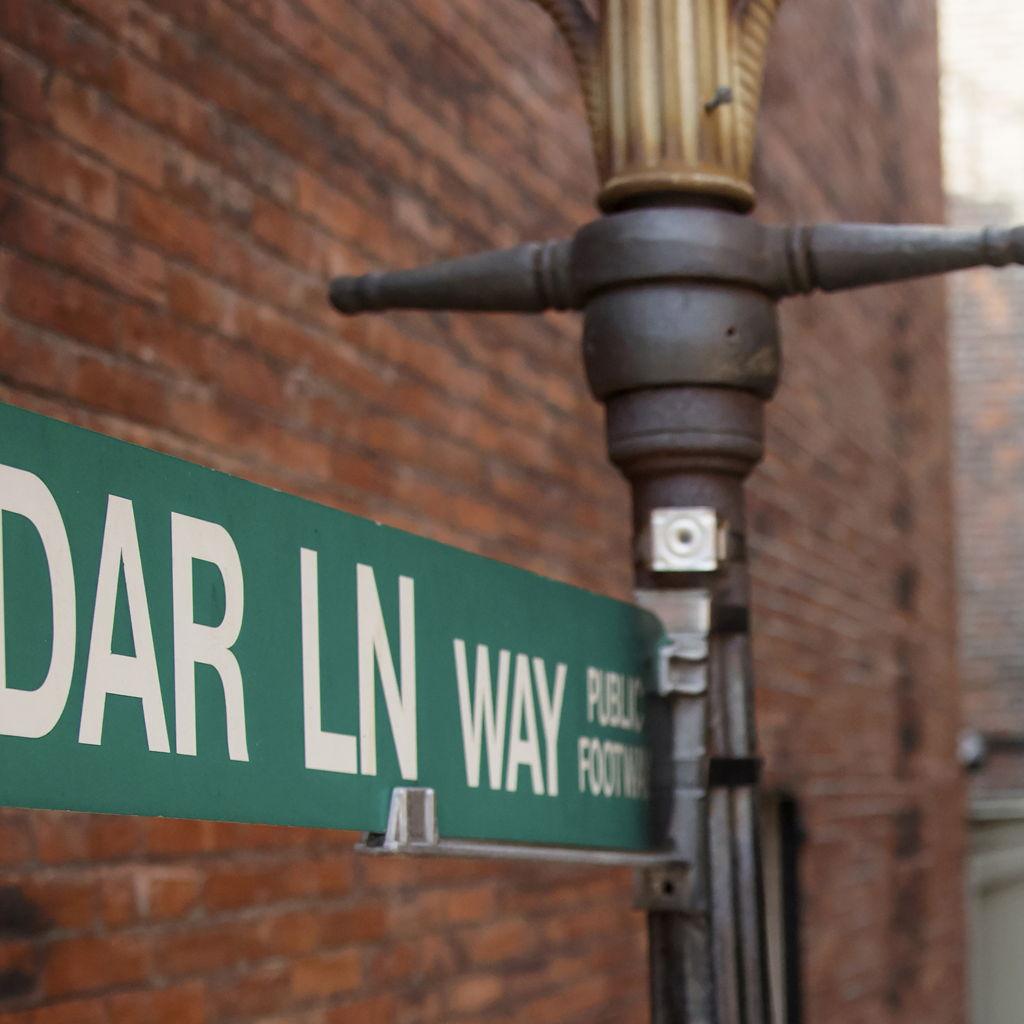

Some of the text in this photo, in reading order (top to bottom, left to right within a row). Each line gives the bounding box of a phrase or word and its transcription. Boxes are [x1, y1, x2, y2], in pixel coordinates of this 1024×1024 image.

[0, 464, 567, 796] DAR LN WAY
[577, 736, 649, 799] FOOTWA
